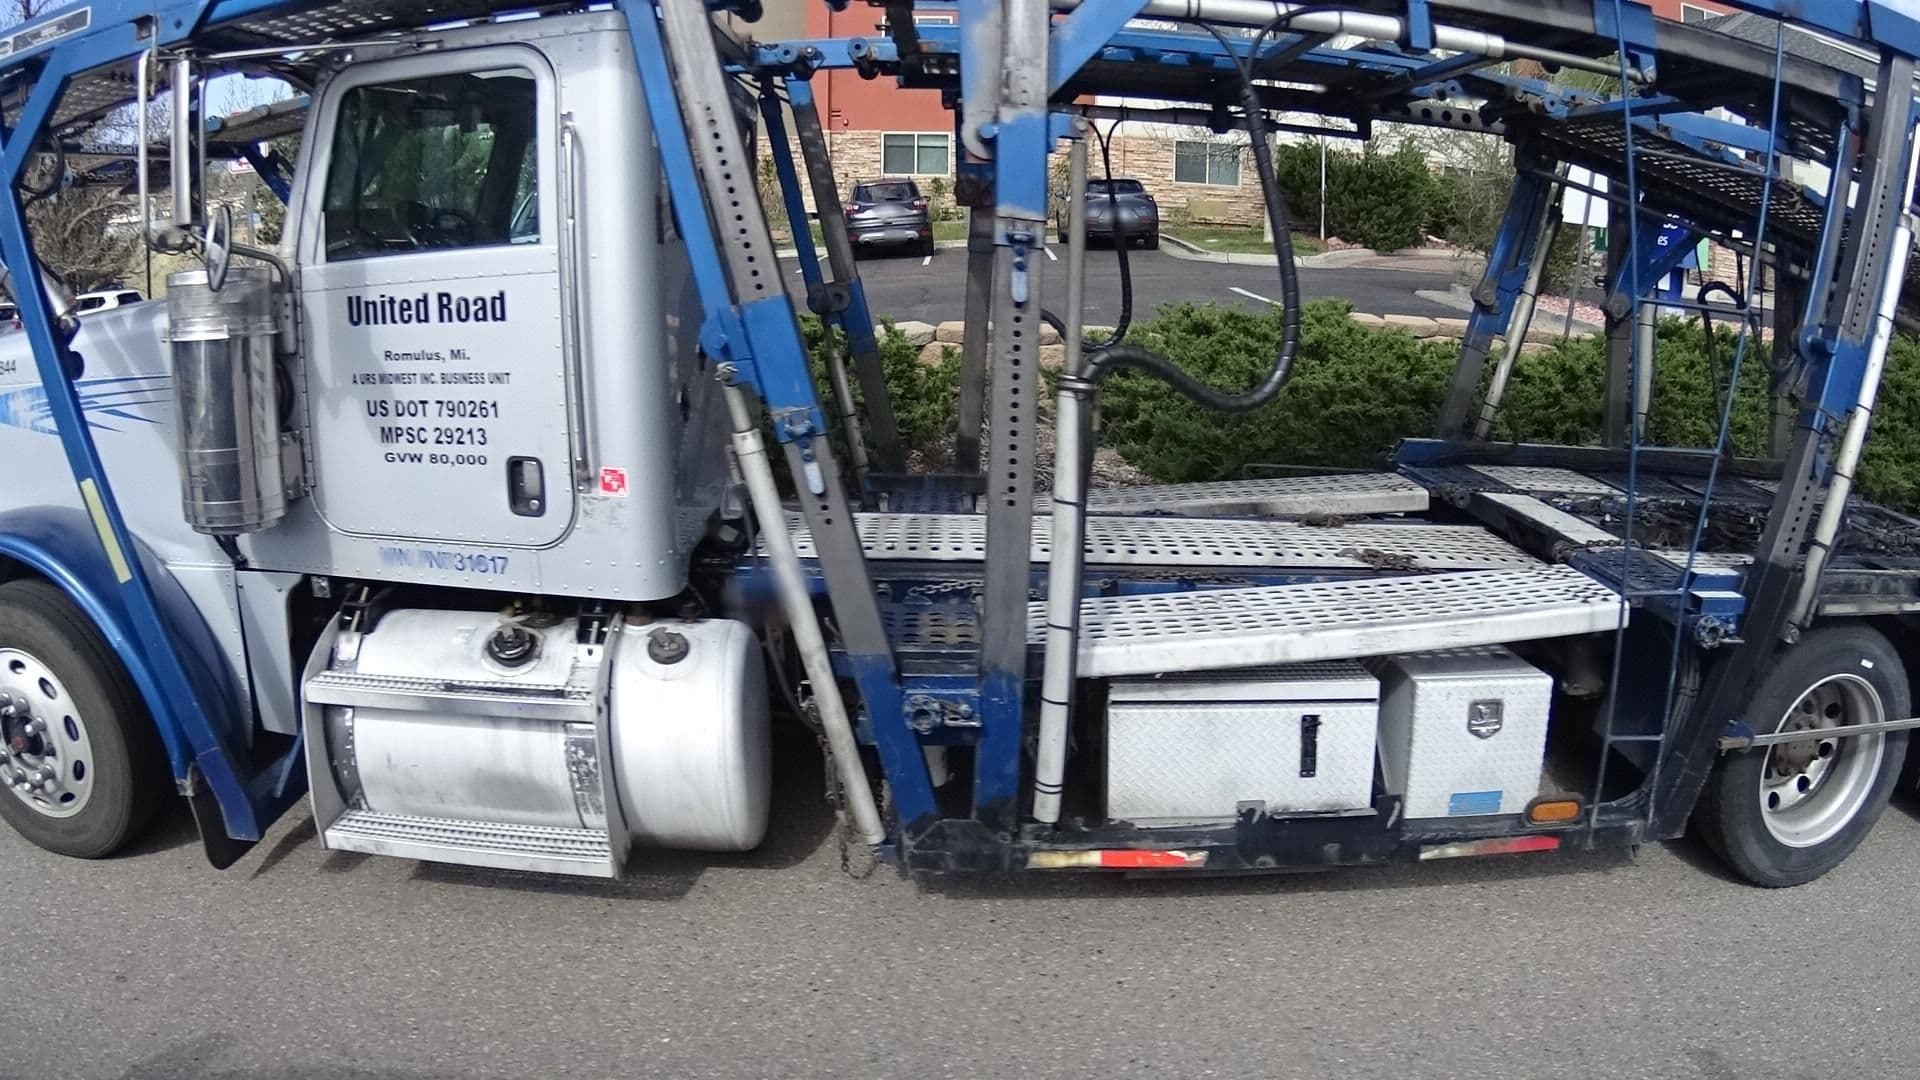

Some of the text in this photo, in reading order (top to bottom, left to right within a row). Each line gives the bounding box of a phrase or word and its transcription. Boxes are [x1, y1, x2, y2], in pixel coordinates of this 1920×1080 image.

[347, 290, 507, 326] United Road
[384, 348, 471, 363] Romulus, Mi.
[352, 373, 359, 384] A
[378, 373, 417, 384] MIDWEST
[441, 372, 486, 384] BUSINESS
[487, 372, 511, 384] UNIT
[366, 400, 499, 418] US DOT 790261
[380, 427, 487, 445] MPSC 29213
[384, 452, 488, 466] GVW 80,000
